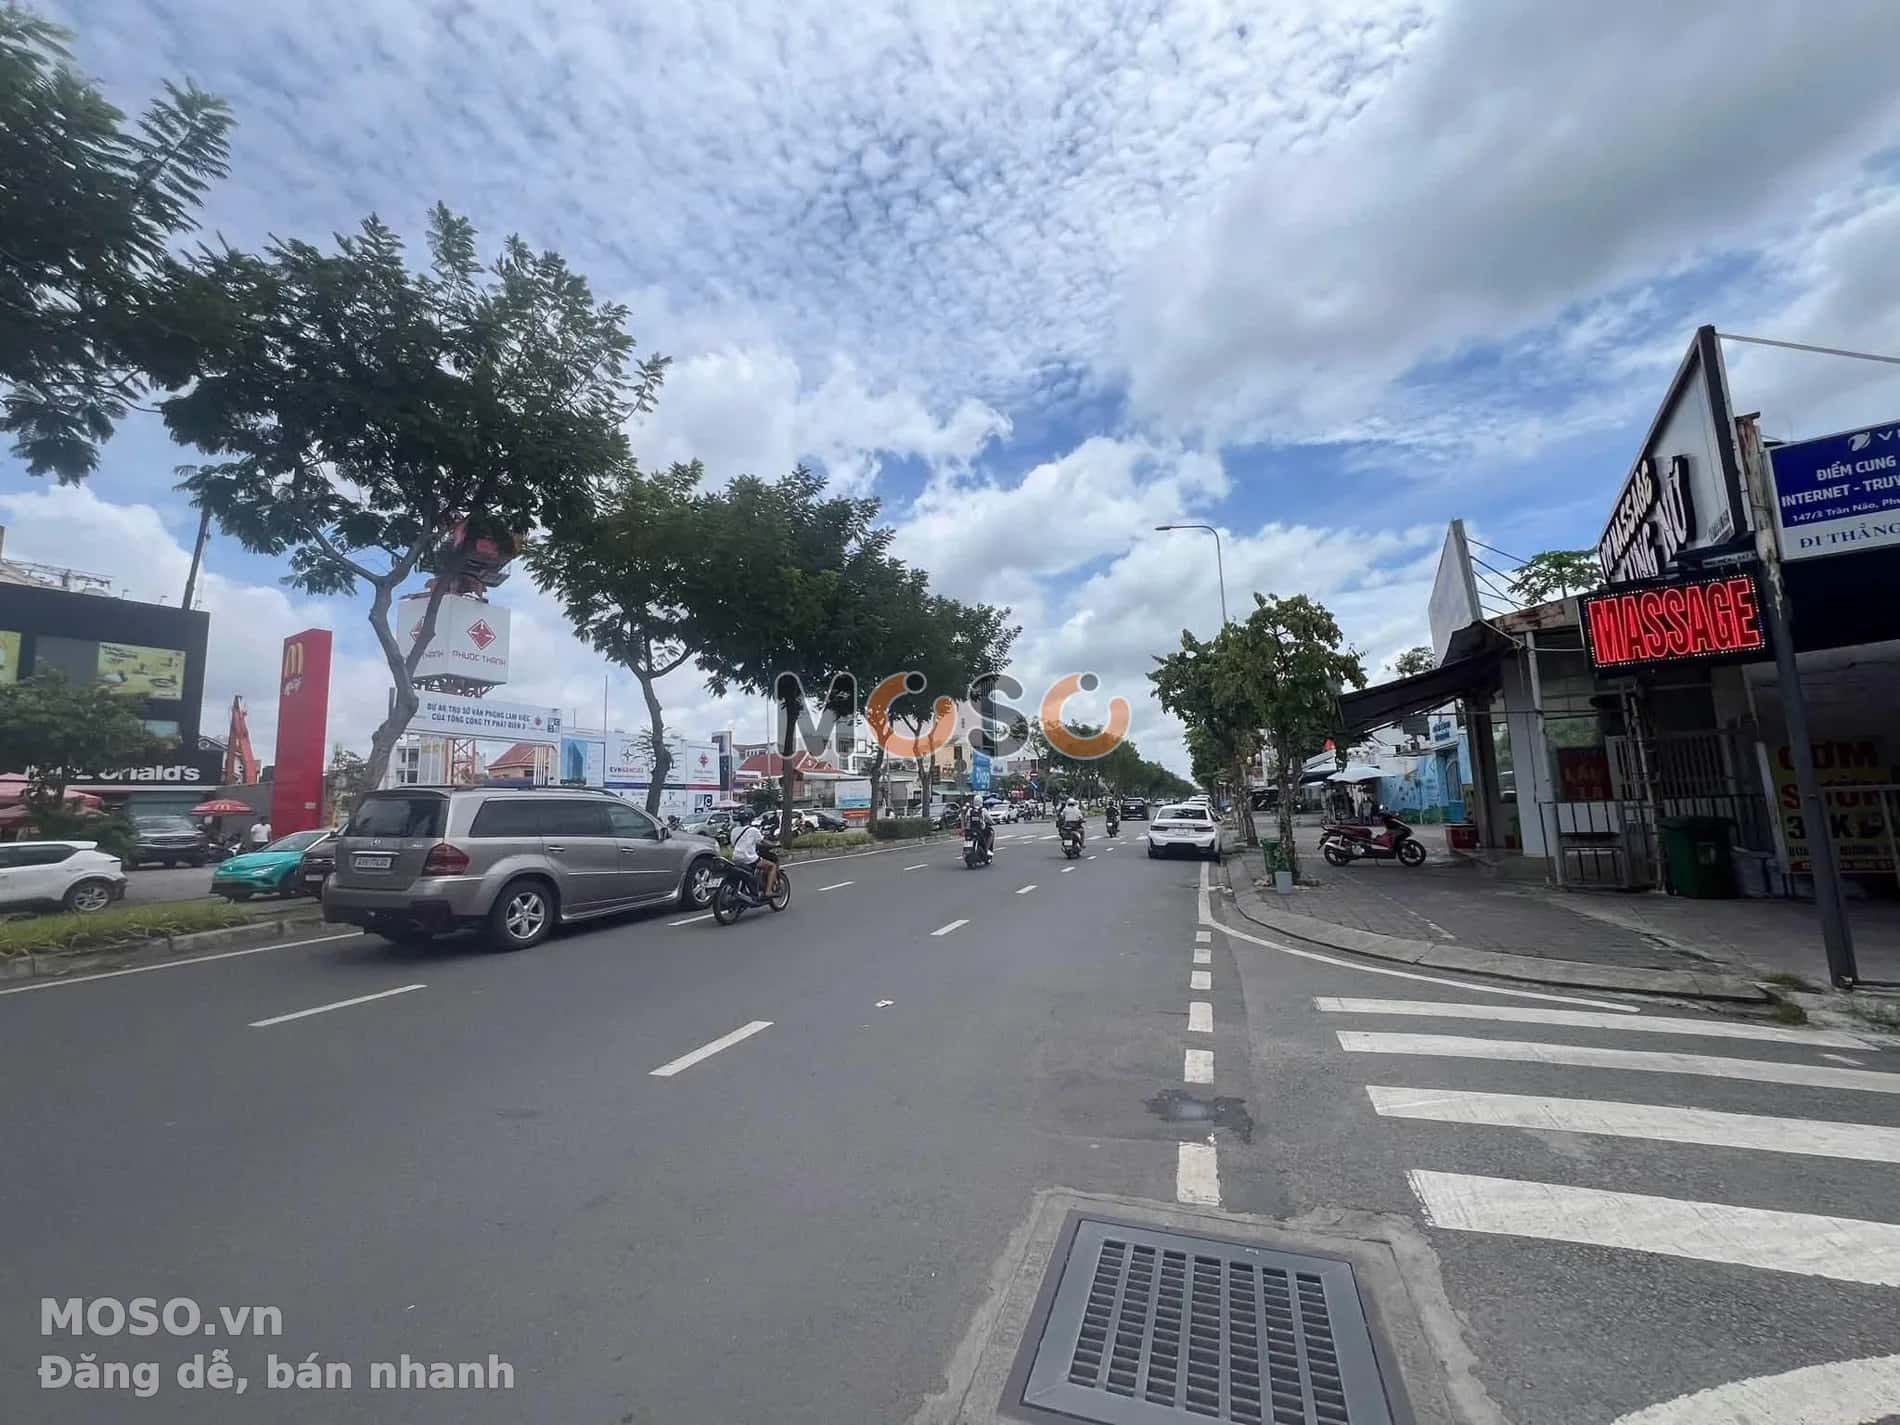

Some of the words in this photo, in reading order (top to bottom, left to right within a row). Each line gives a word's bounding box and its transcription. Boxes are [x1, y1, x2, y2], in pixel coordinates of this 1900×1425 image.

[1877, 427, 1900, 441] V
[1816, 461, 1852, 481] ĐIỂM
[1856, 455, 1897, 473] CUNG
[1781, 484, 1850, 508] INTERNET
[1609, 459, 1653, 561] MASSAGE
[1588, 578, 1760, 665] MASSAGE
[1786, 813, 1854, 839] 3K
